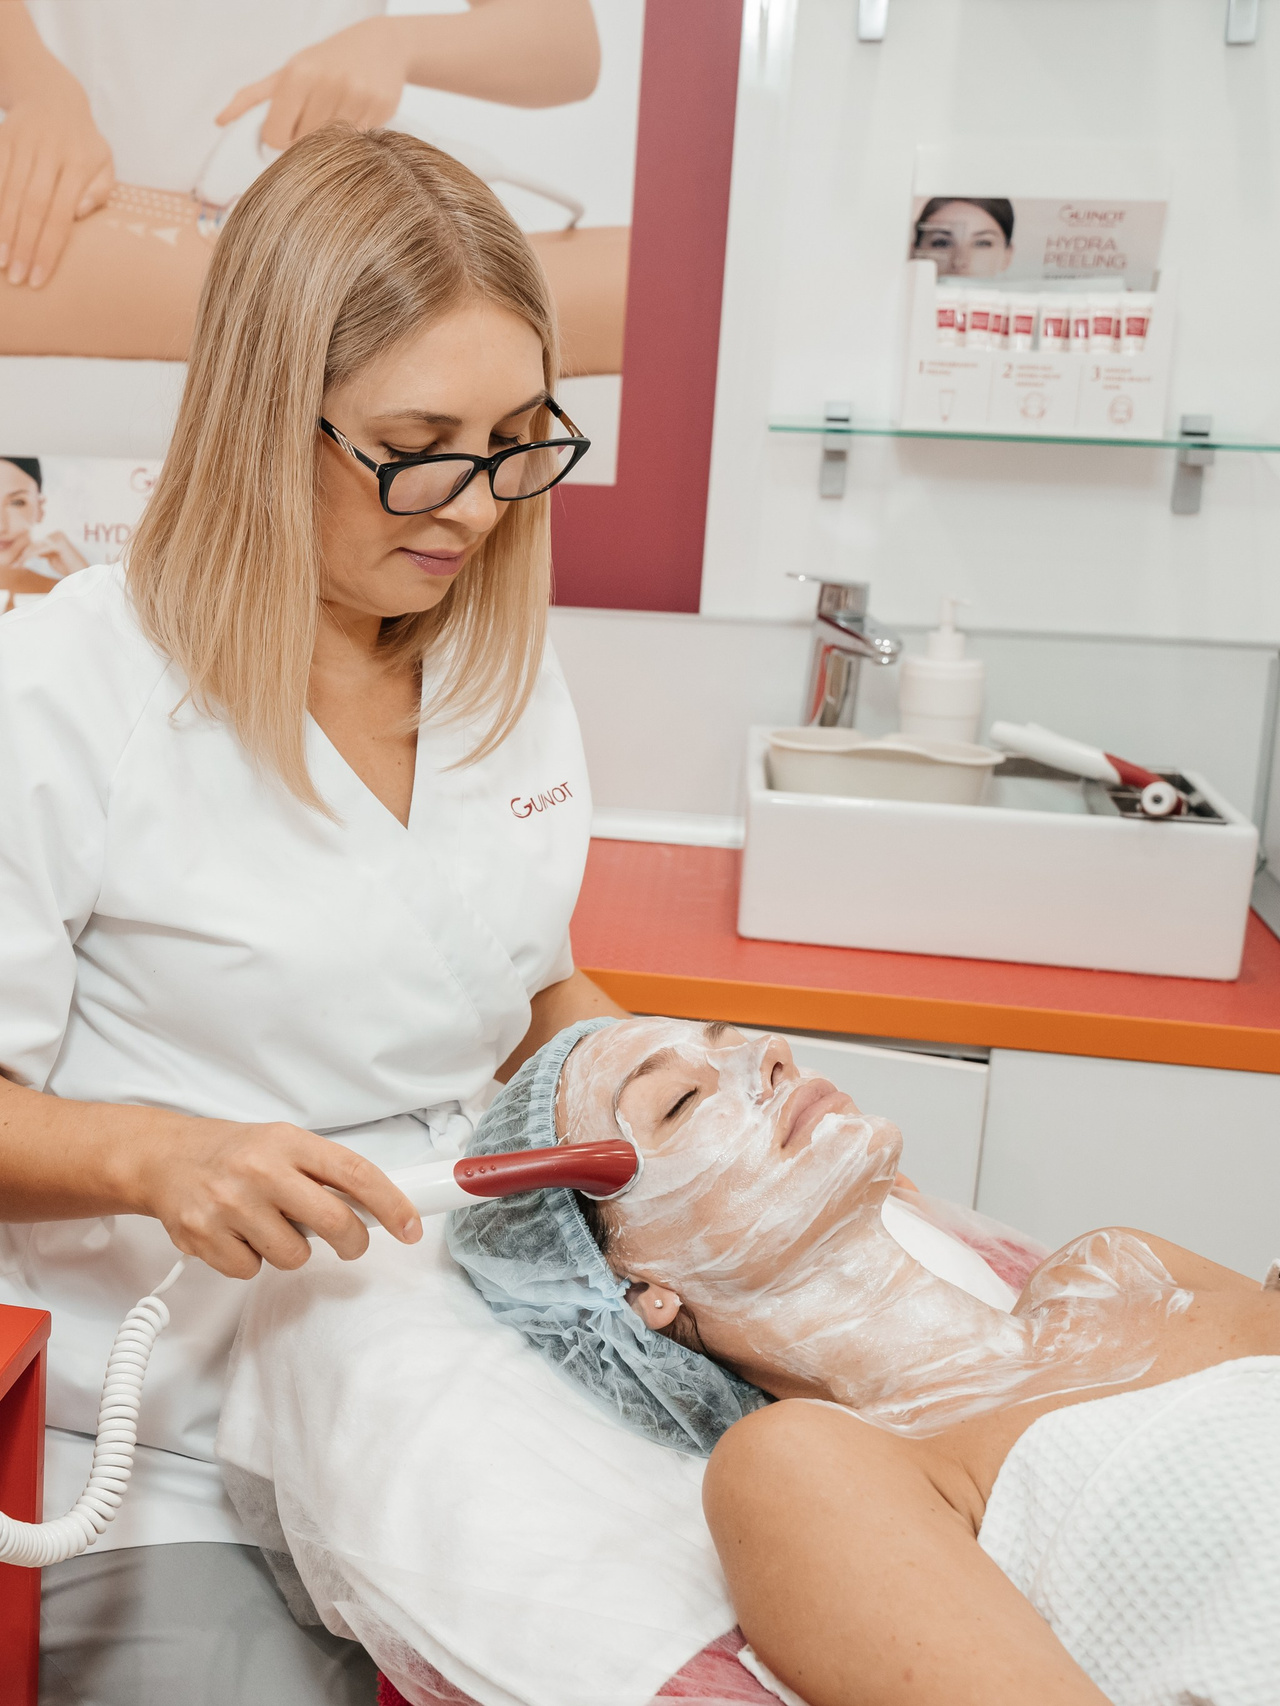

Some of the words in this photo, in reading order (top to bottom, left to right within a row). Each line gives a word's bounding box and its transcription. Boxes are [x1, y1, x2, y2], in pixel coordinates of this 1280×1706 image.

[1059, 204, 1126, 222] GUINOT
[1045, 236, 1118, 251] HYDRA
[1043, 252, 1128, 270] PEELING
[84, 522, 131, 543] HYD
[510, 781, 573, 819] GUINOT
